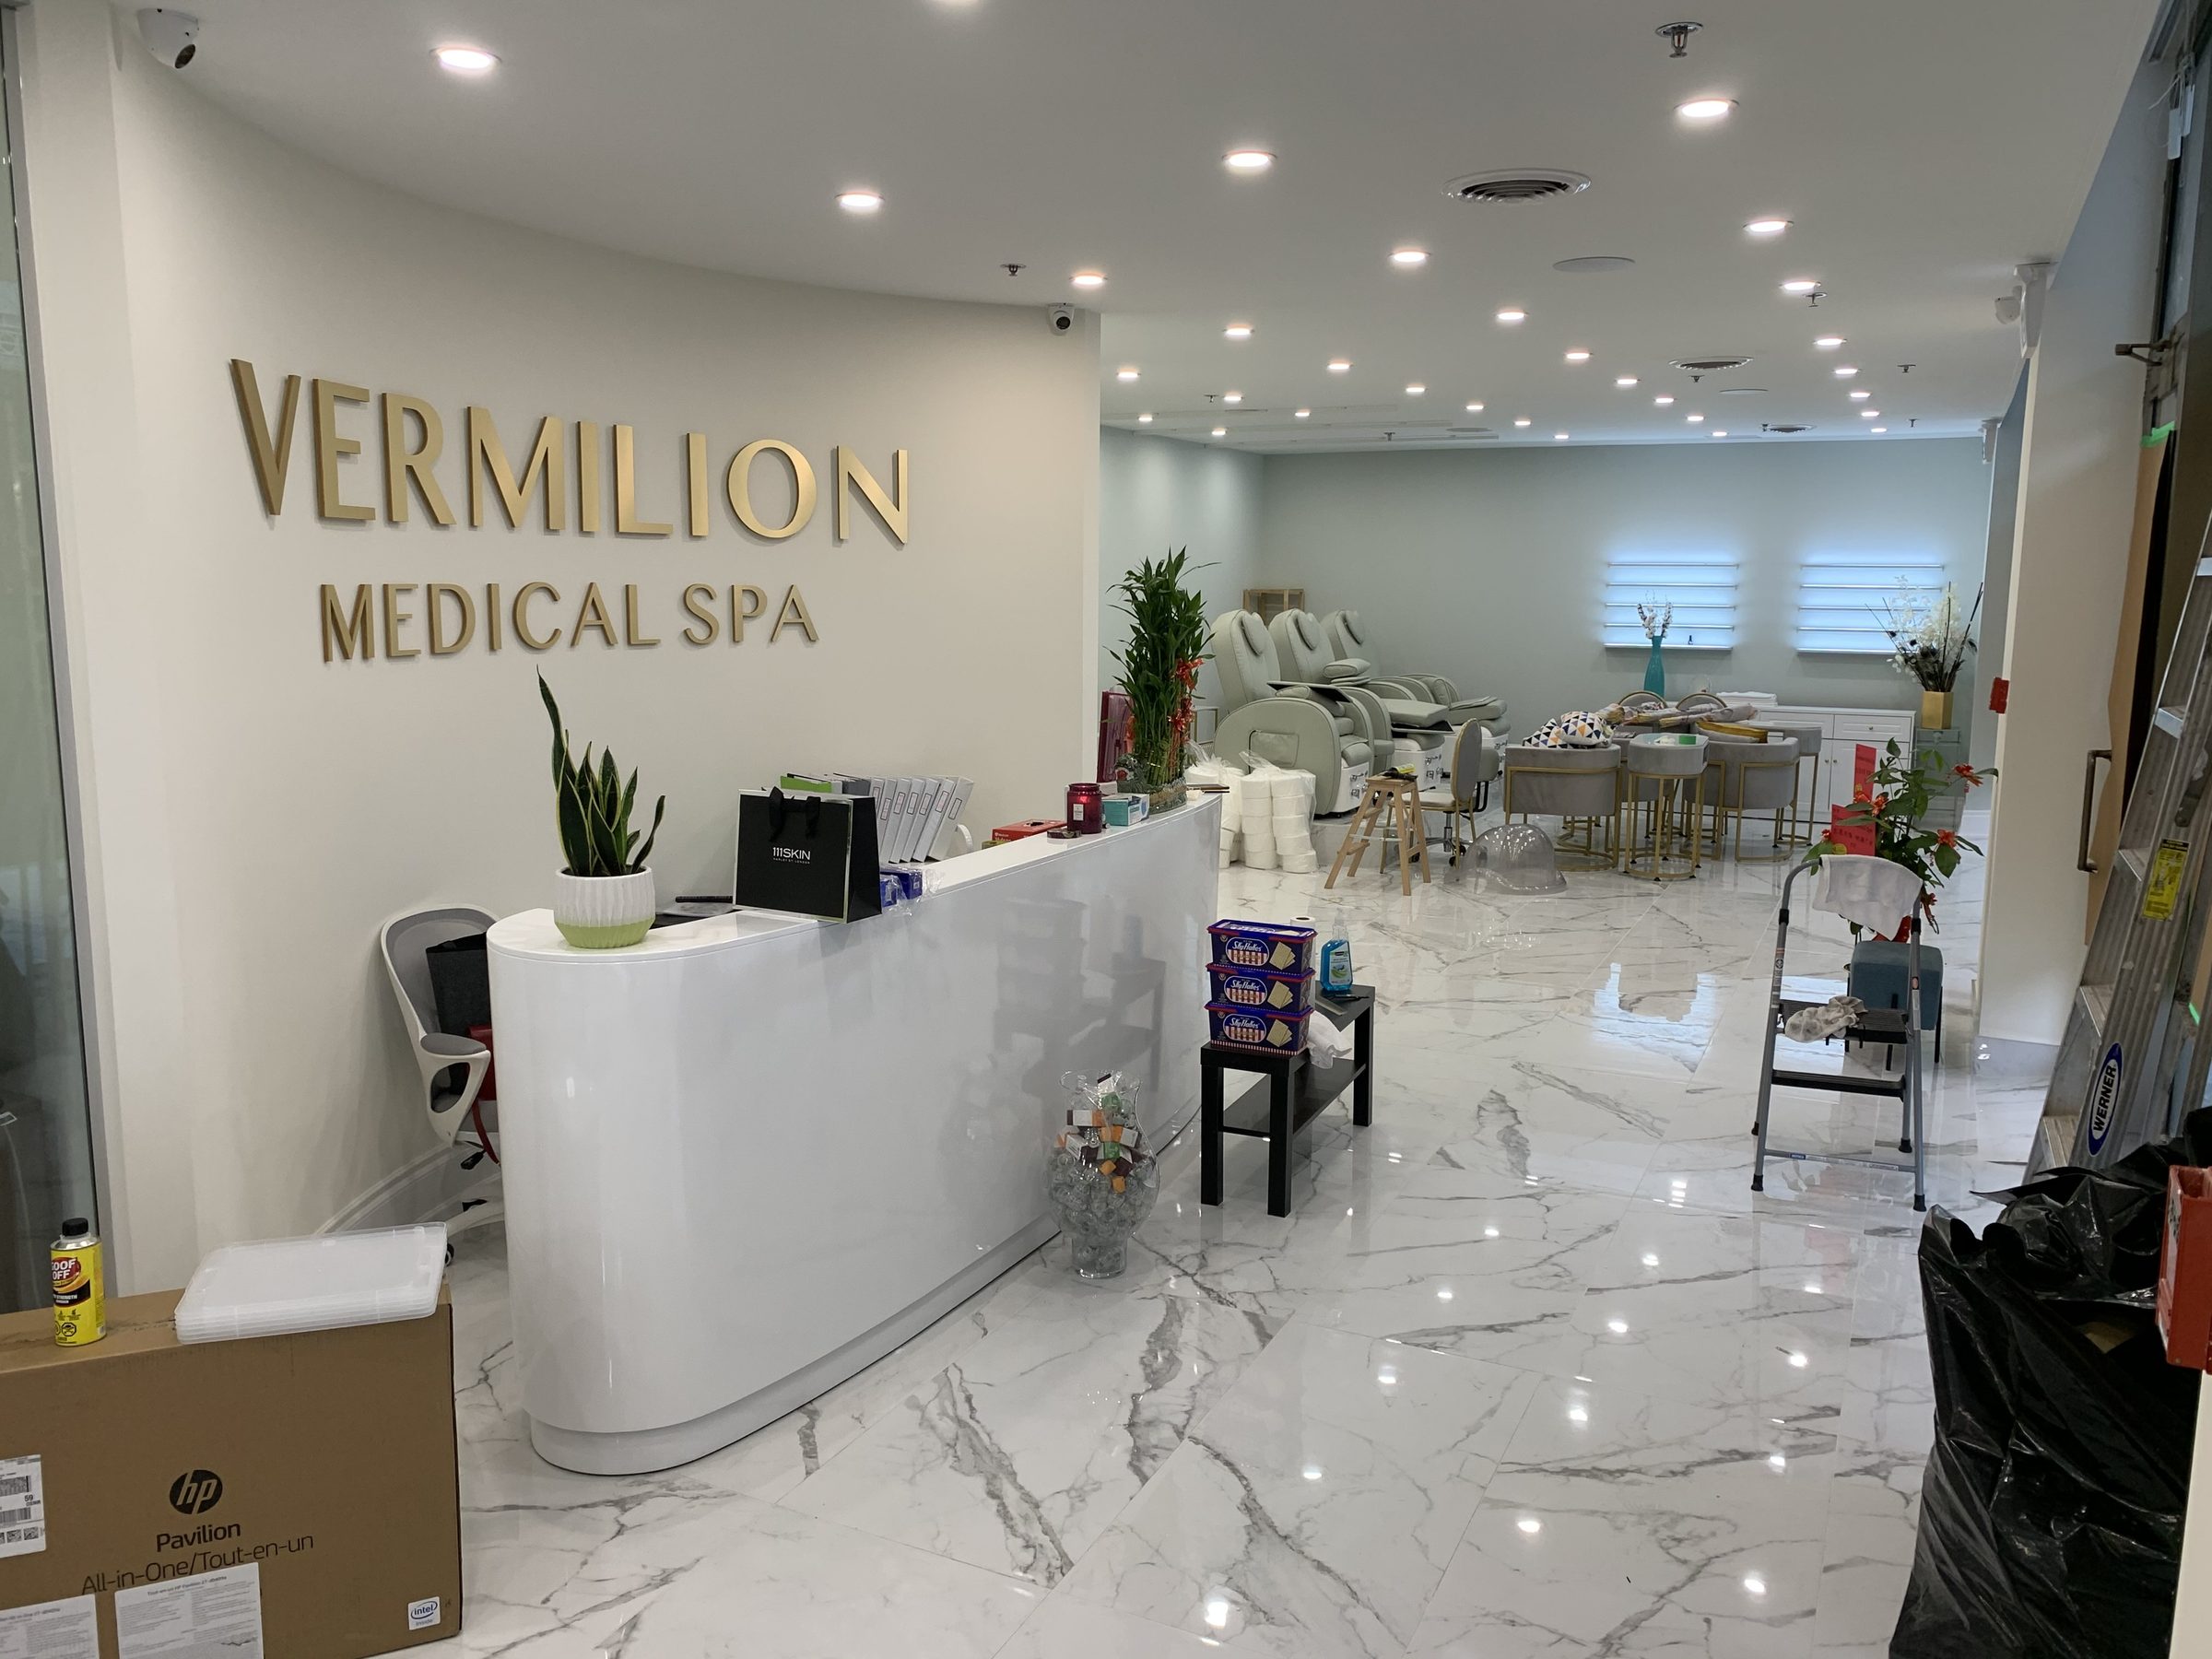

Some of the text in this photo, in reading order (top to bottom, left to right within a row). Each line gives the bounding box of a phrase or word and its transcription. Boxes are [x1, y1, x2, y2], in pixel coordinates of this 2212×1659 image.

[229, 358, 909, 547] VERMILION
[320, 581, 820, 664] MEDICAL SPA
[772, 847, 811, 860] 111SKIN
[2093, 1064, 2117, 1132] WERNER
[52, 1269, 71, 1280] OFF
[174, 1471, 218, 1514] hp
[156, 1523, 241, 1552] Pavilion
[81, 1535, 314, 1595] All-in-One/Tout-en-un
[414, 1604, 434, 1616] intel
